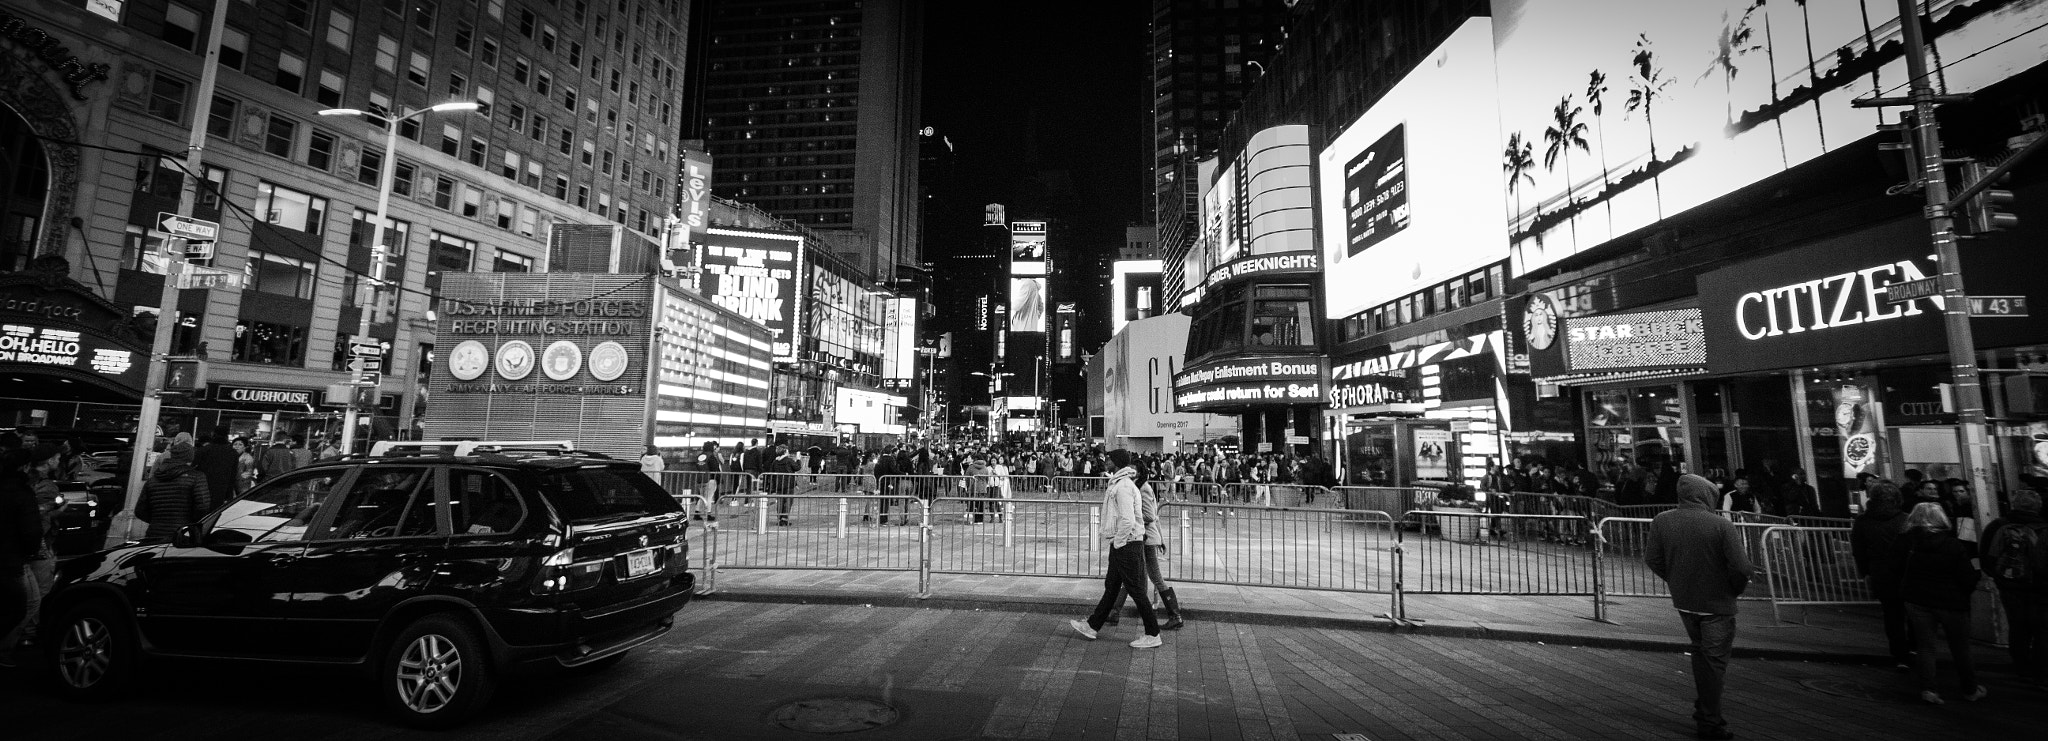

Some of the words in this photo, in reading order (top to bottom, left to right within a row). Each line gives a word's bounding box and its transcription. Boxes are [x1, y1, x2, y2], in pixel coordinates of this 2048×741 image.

[176, 222, 193, 232] ONE
[195, 226, 212, 235] WAY
[192, 275, 202, 287] W
[204, 275, 216, 288] 43
[718, 273, 779, 299] BLIND
[1887, 278, 1937, 301] BROADWAY
[445, 302, 476, 316] U.S.
[481, 299, 560, 317] ARMED
[561, 301, 645, 318] FORCES
[980, 294, 988, 331] NOVOTEL
[1971, 300, 1984, 314] W
[1988, 299, 2010, 314] 43
[452, 320, 556, 335] RECRUITING
[558, 320, 632, 336] STATION
[30, 339, 80, 355] HELLO
[1598, 340, 1690, 359] COFFEE
[17, 352, 78, 366] BROADWAY
[1214, 364, 1267, 379] Enlistment
[1271, 362, 1317, 375] Bonus
[232, 388, 309, 404] CLUBHOUSE
[1264, 385, 1286, 399] for
[1329, 383, 1382, 409] SEPHORA
[1156, 421, 1177, 429] Opening
[1177, 420, 1188, 428] 2017
